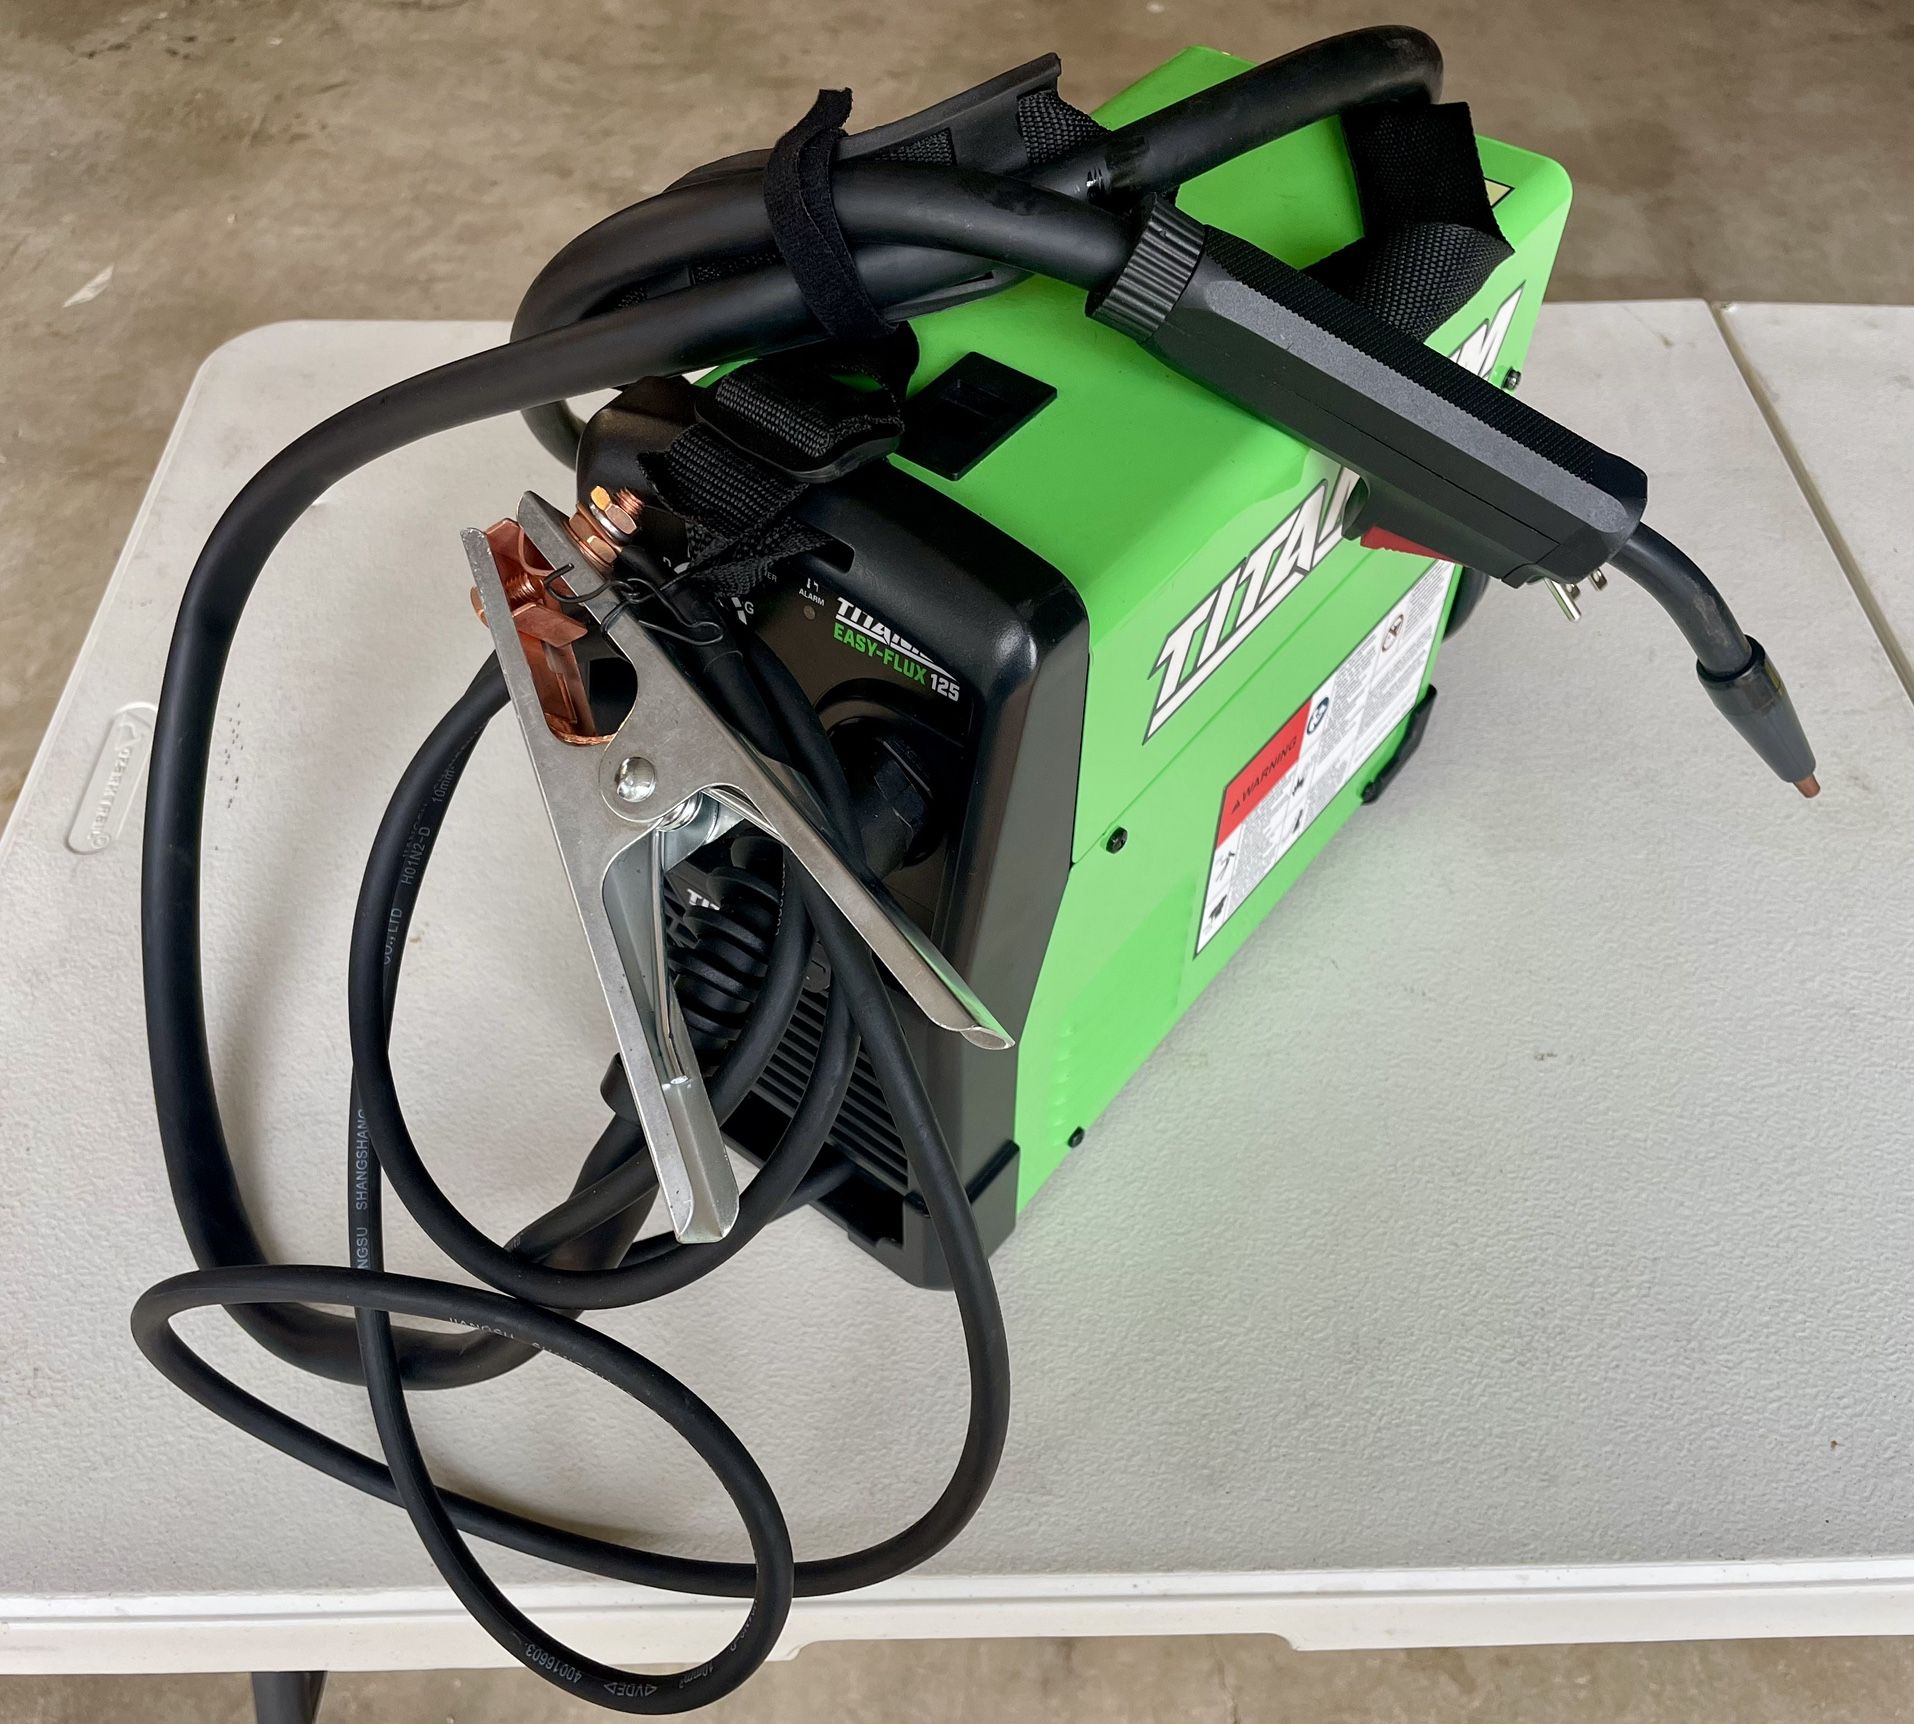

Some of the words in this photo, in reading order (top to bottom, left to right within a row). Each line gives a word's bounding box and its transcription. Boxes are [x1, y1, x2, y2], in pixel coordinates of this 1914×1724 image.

[799, 588, 825, 606] ALARM
[833, 622, 926, 686] EASY-FLUX
[930, 673, 960, 702] 125
[1242, 735, 1297, 802] WARNING
[401, 827, 431, 885] H01N2-D
[525, 1643, 583, 1683] 40016603
